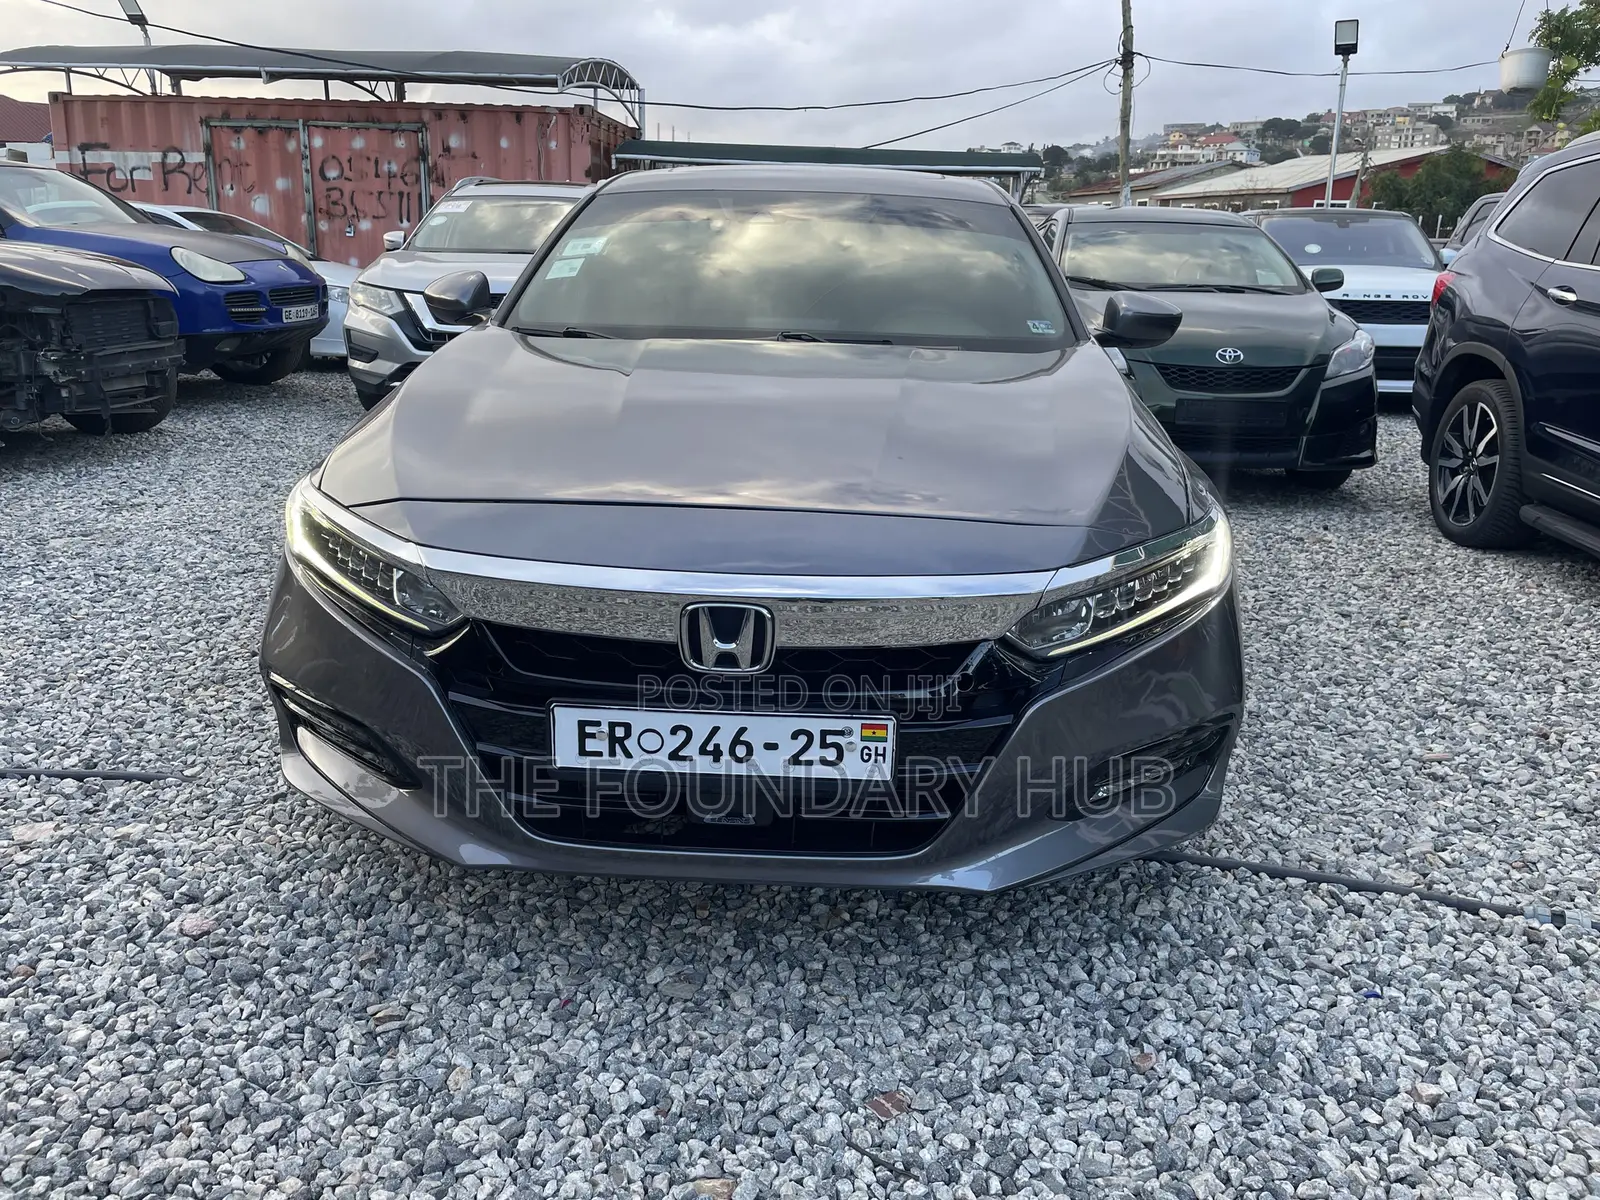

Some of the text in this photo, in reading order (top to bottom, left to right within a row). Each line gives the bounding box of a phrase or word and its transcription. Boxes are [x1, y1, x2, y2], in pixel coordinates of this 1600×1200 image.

[77, 142, 151, 193] For
[577, 719, 634, 760] ER
[860, 745, 888, 765] GH
